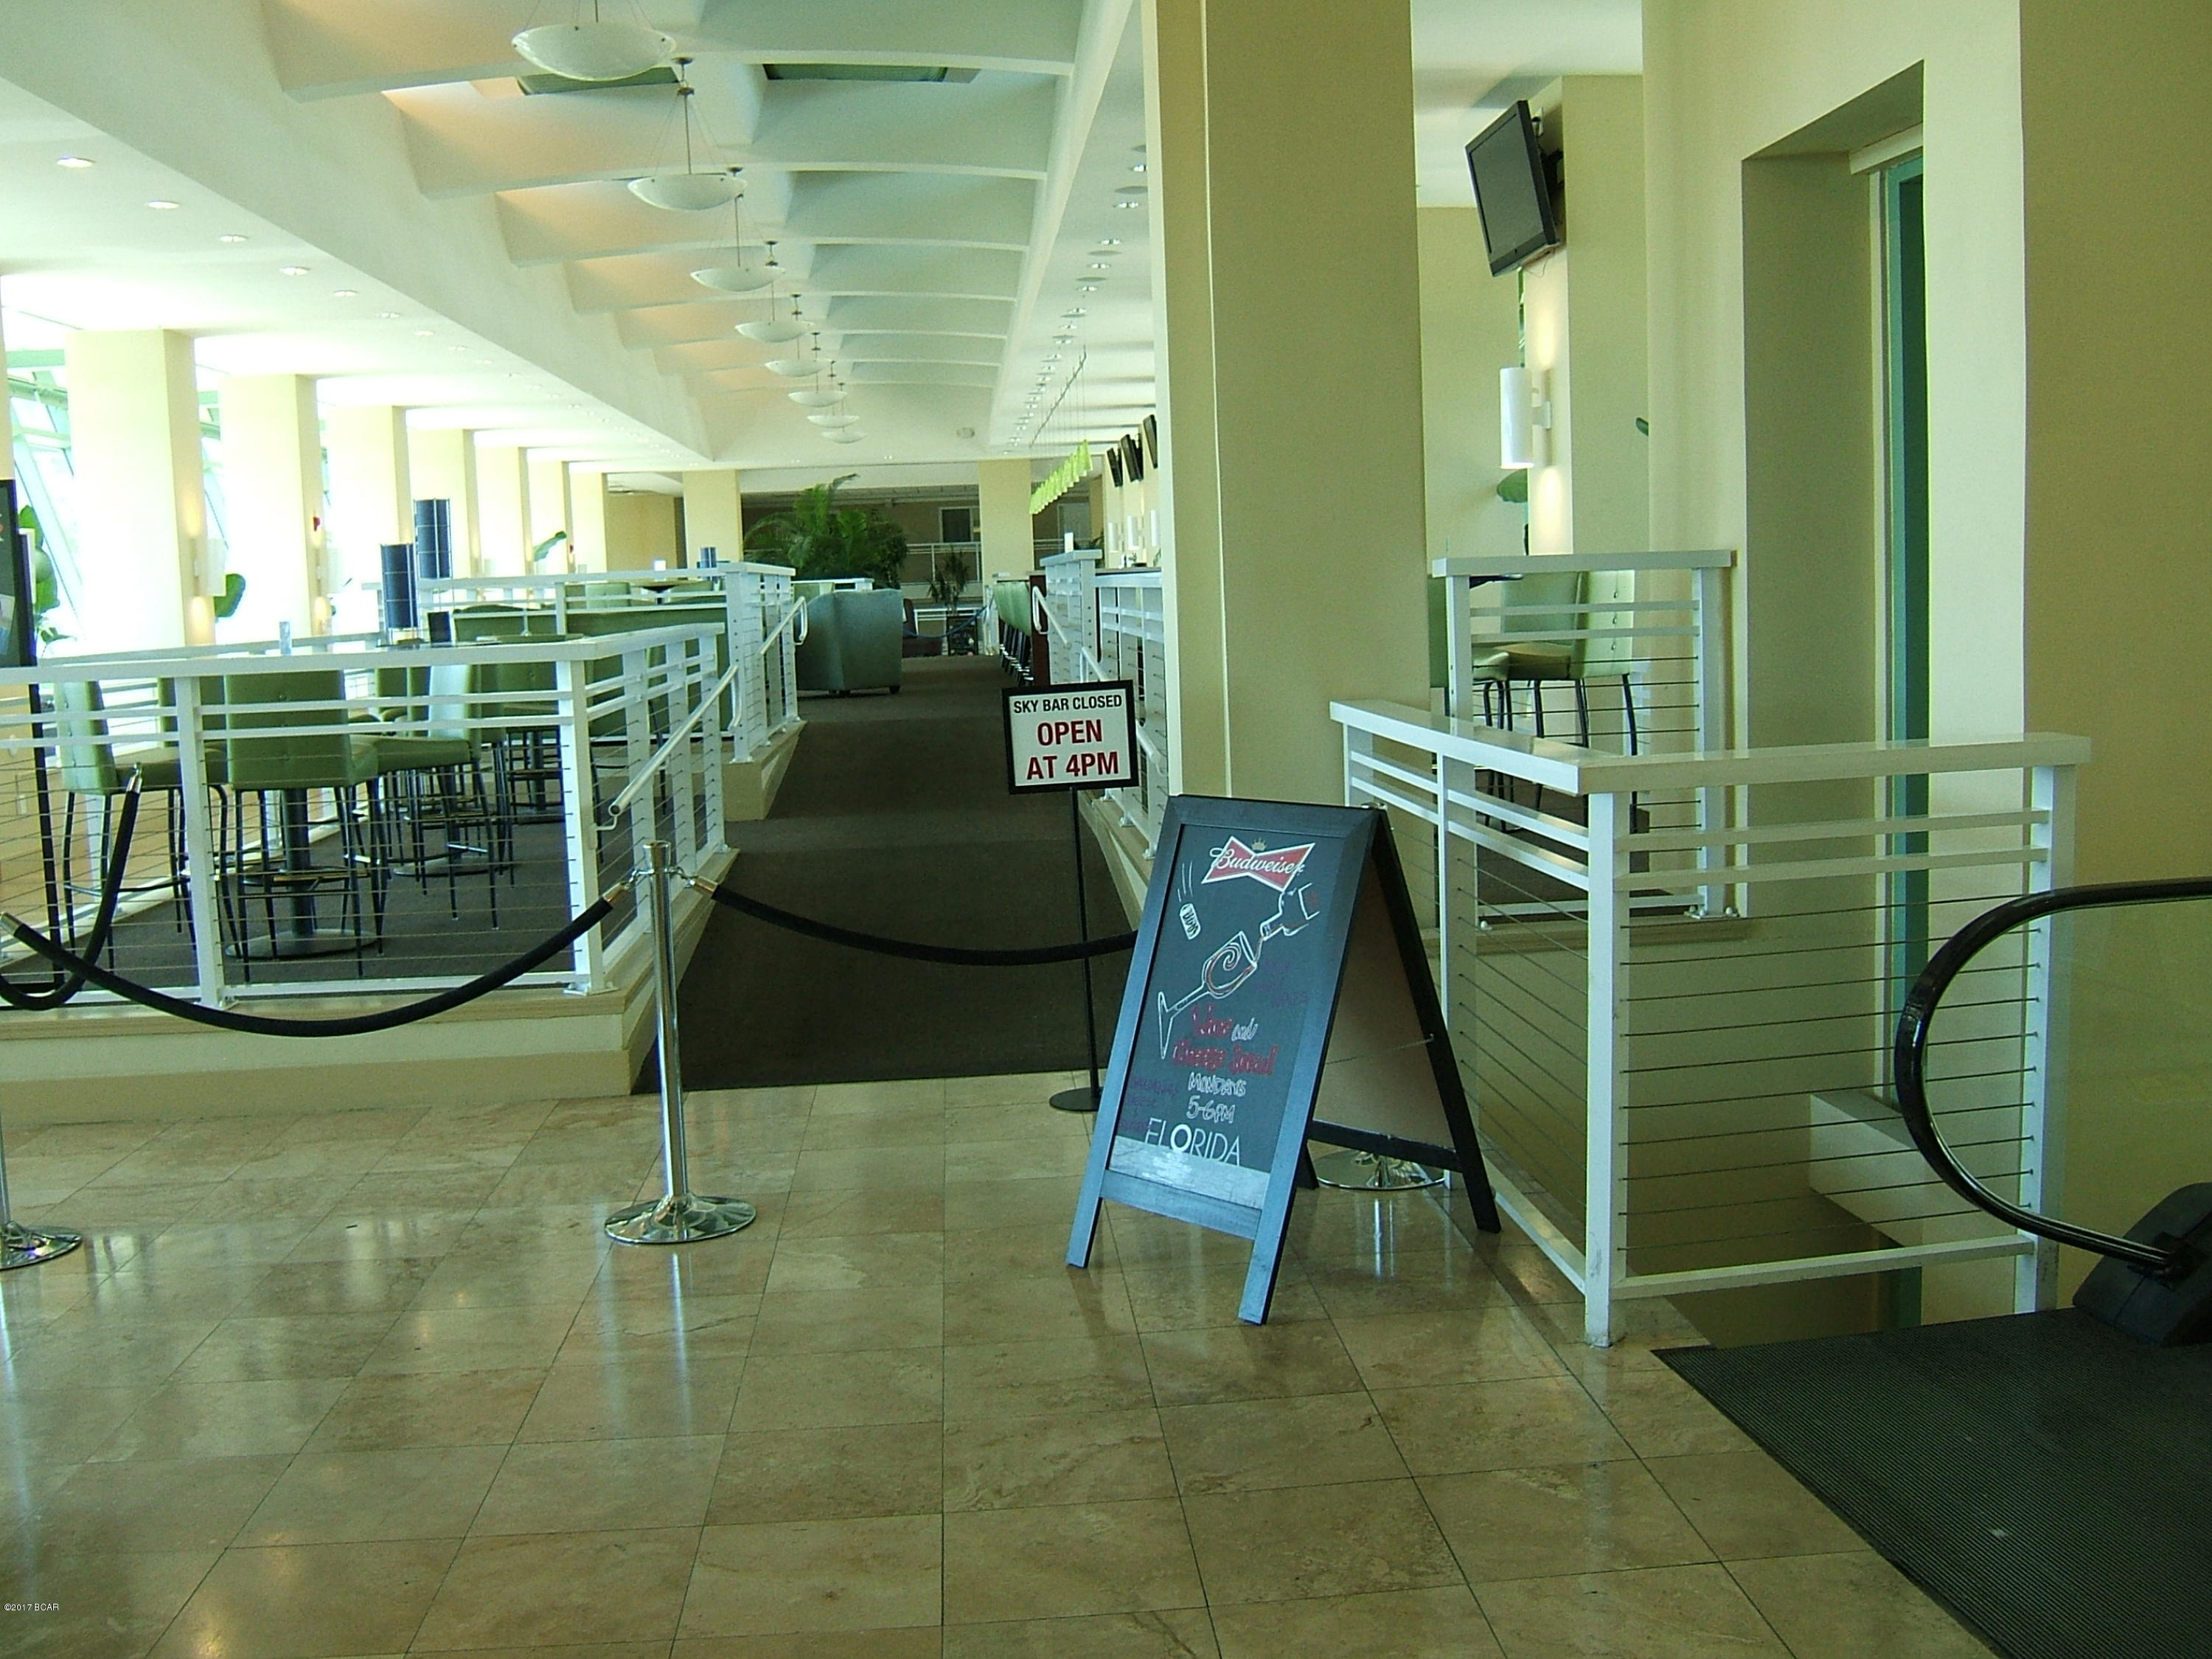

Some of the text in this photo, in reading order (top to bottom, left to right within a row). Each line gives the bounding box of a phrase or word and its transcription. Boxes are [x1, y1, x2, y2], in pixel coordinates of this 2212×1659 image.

[1014, 695, 1122, 713] SKY BAR CLOSED
[1037, 719, 1102, 745] OPEN
[1027, 751, 1119, 780] AT 4PM
[1209, 848, 1305, 875] Budweiser
[1144, 1117, 1241, 1166] FLORIDA
